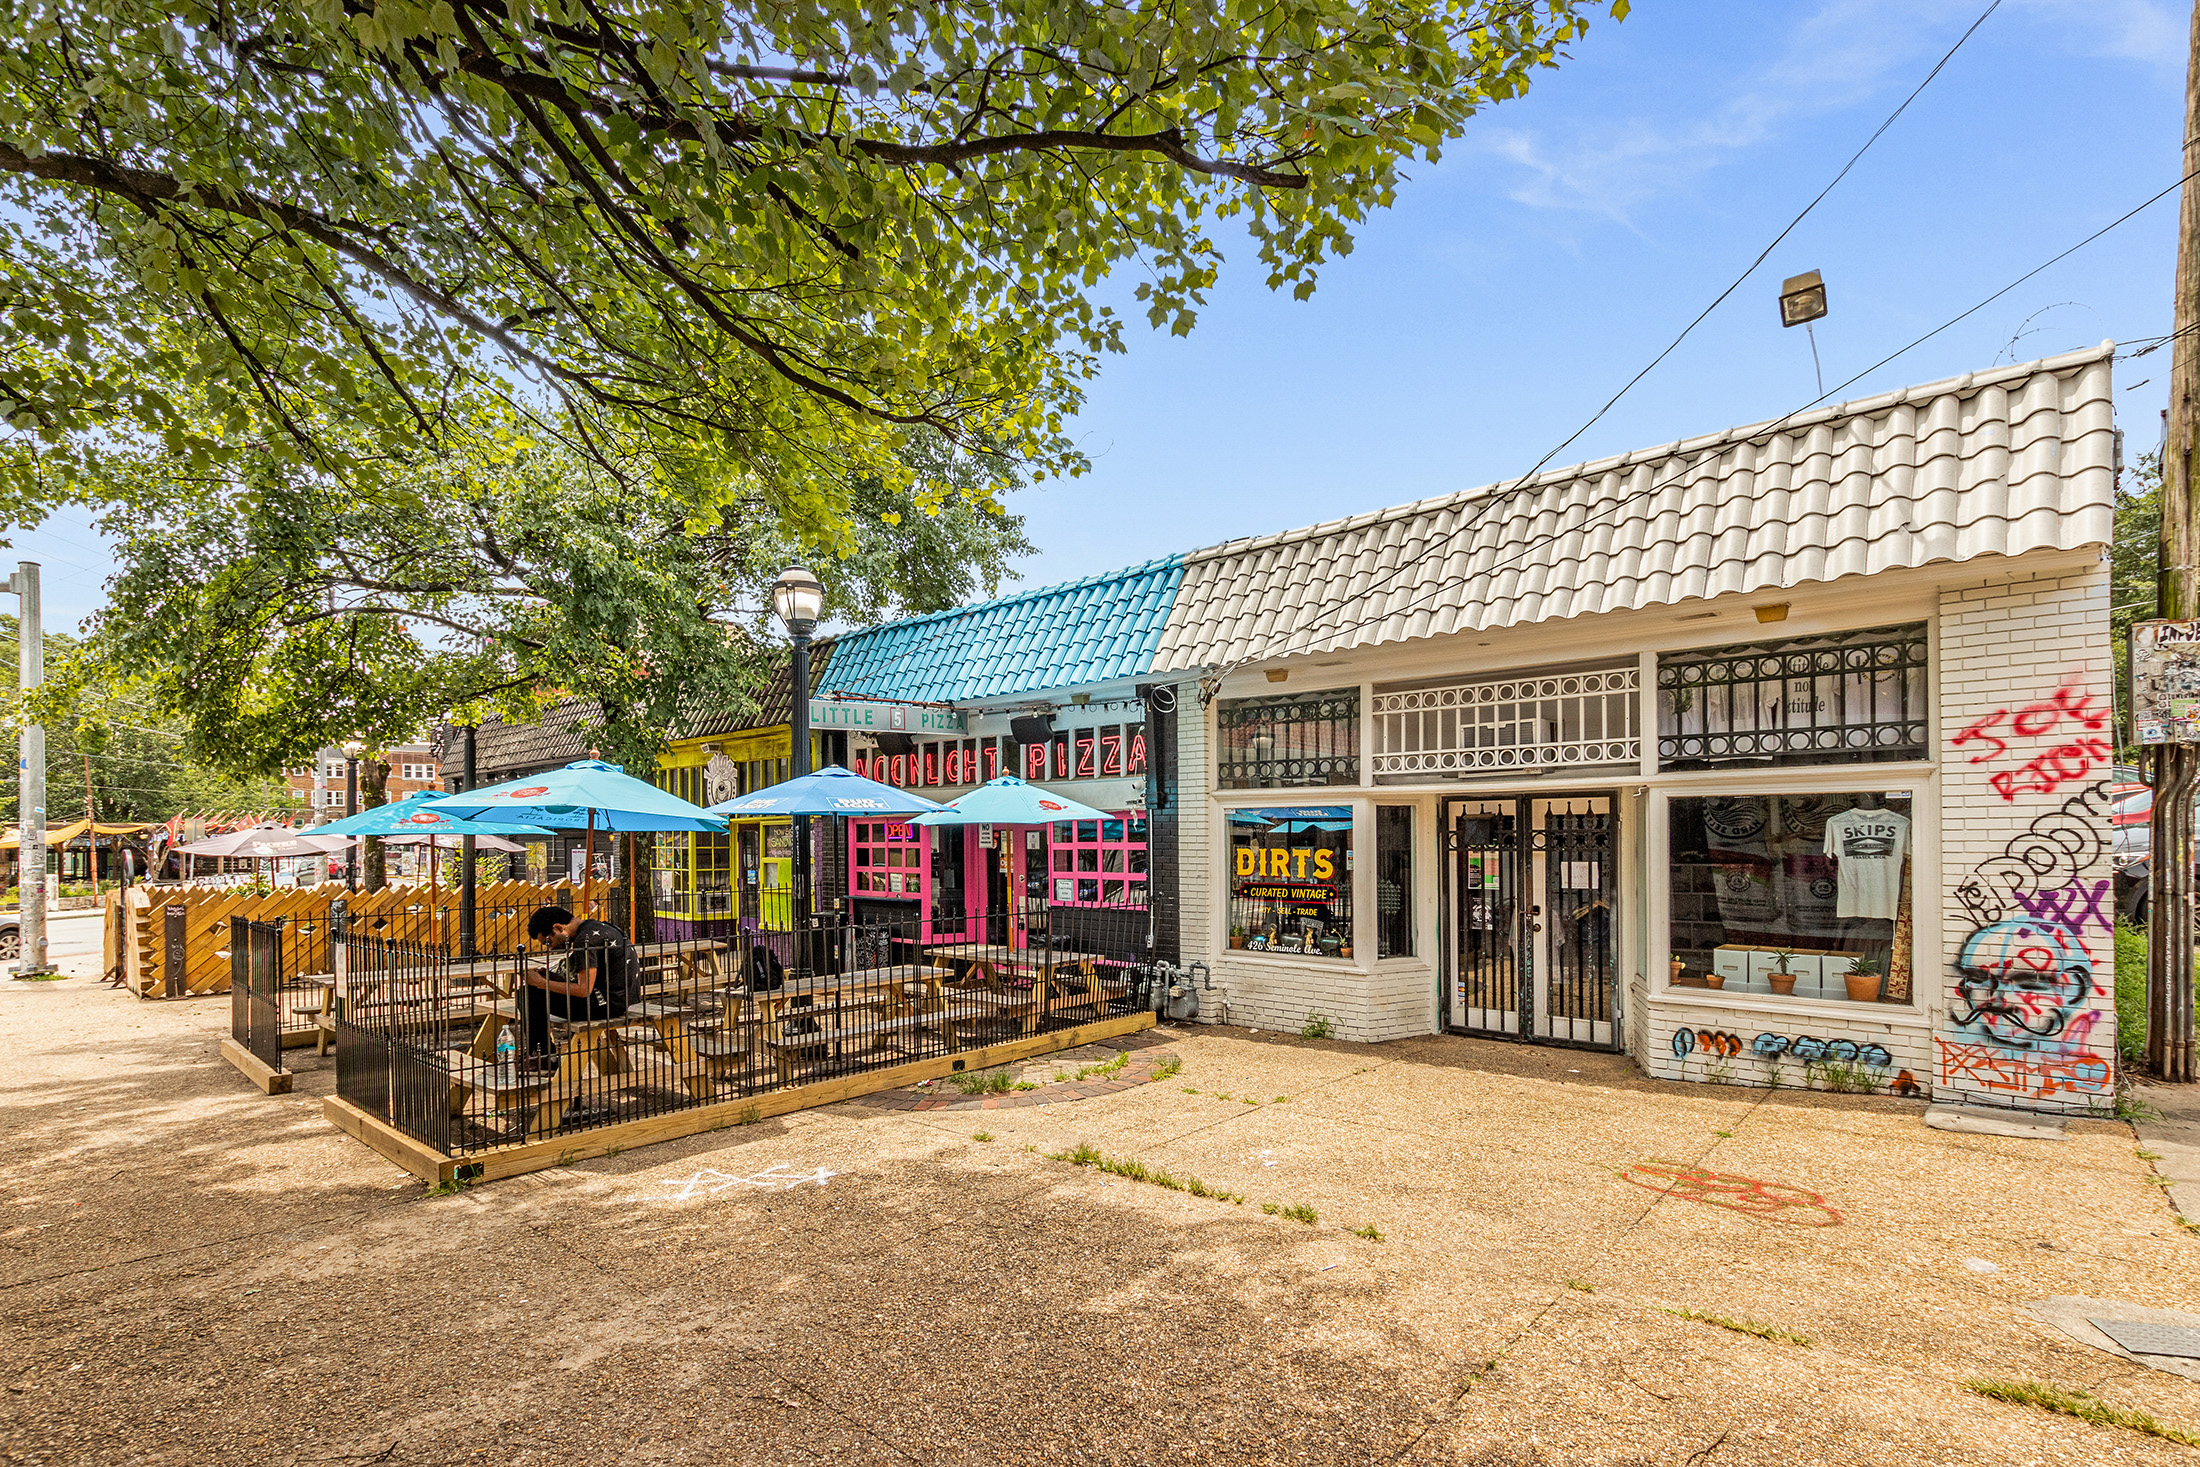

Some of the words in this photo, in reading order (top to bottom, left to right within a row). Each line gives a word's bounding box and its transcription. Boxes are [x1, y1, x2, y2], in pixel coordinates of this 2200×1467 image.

[810, 706, 874, 725] LITTLE
[894, 713, 902, 727] 5
[921, 713, 965, 730] PIZZA
[1028, 734, 1147, 779] PIZZA
[888, 824, 912, 836] OPEN
[1844, 825, 1896, 838] SKIPS
[1236, 848, 1335, 880] DIRTS
[1250, 887, 1288, 898] CURATED
[1291, 889, 1327, 899] VINTAGE
[1277, 907, 1292, 915] SELL
[1296, 908, 1318, 916] TRADE
[1247, 940, 1264, 951] 426
[1265, 940, 1301, 954] Seminole
[1304, 945, 1323, 955] Ave.
